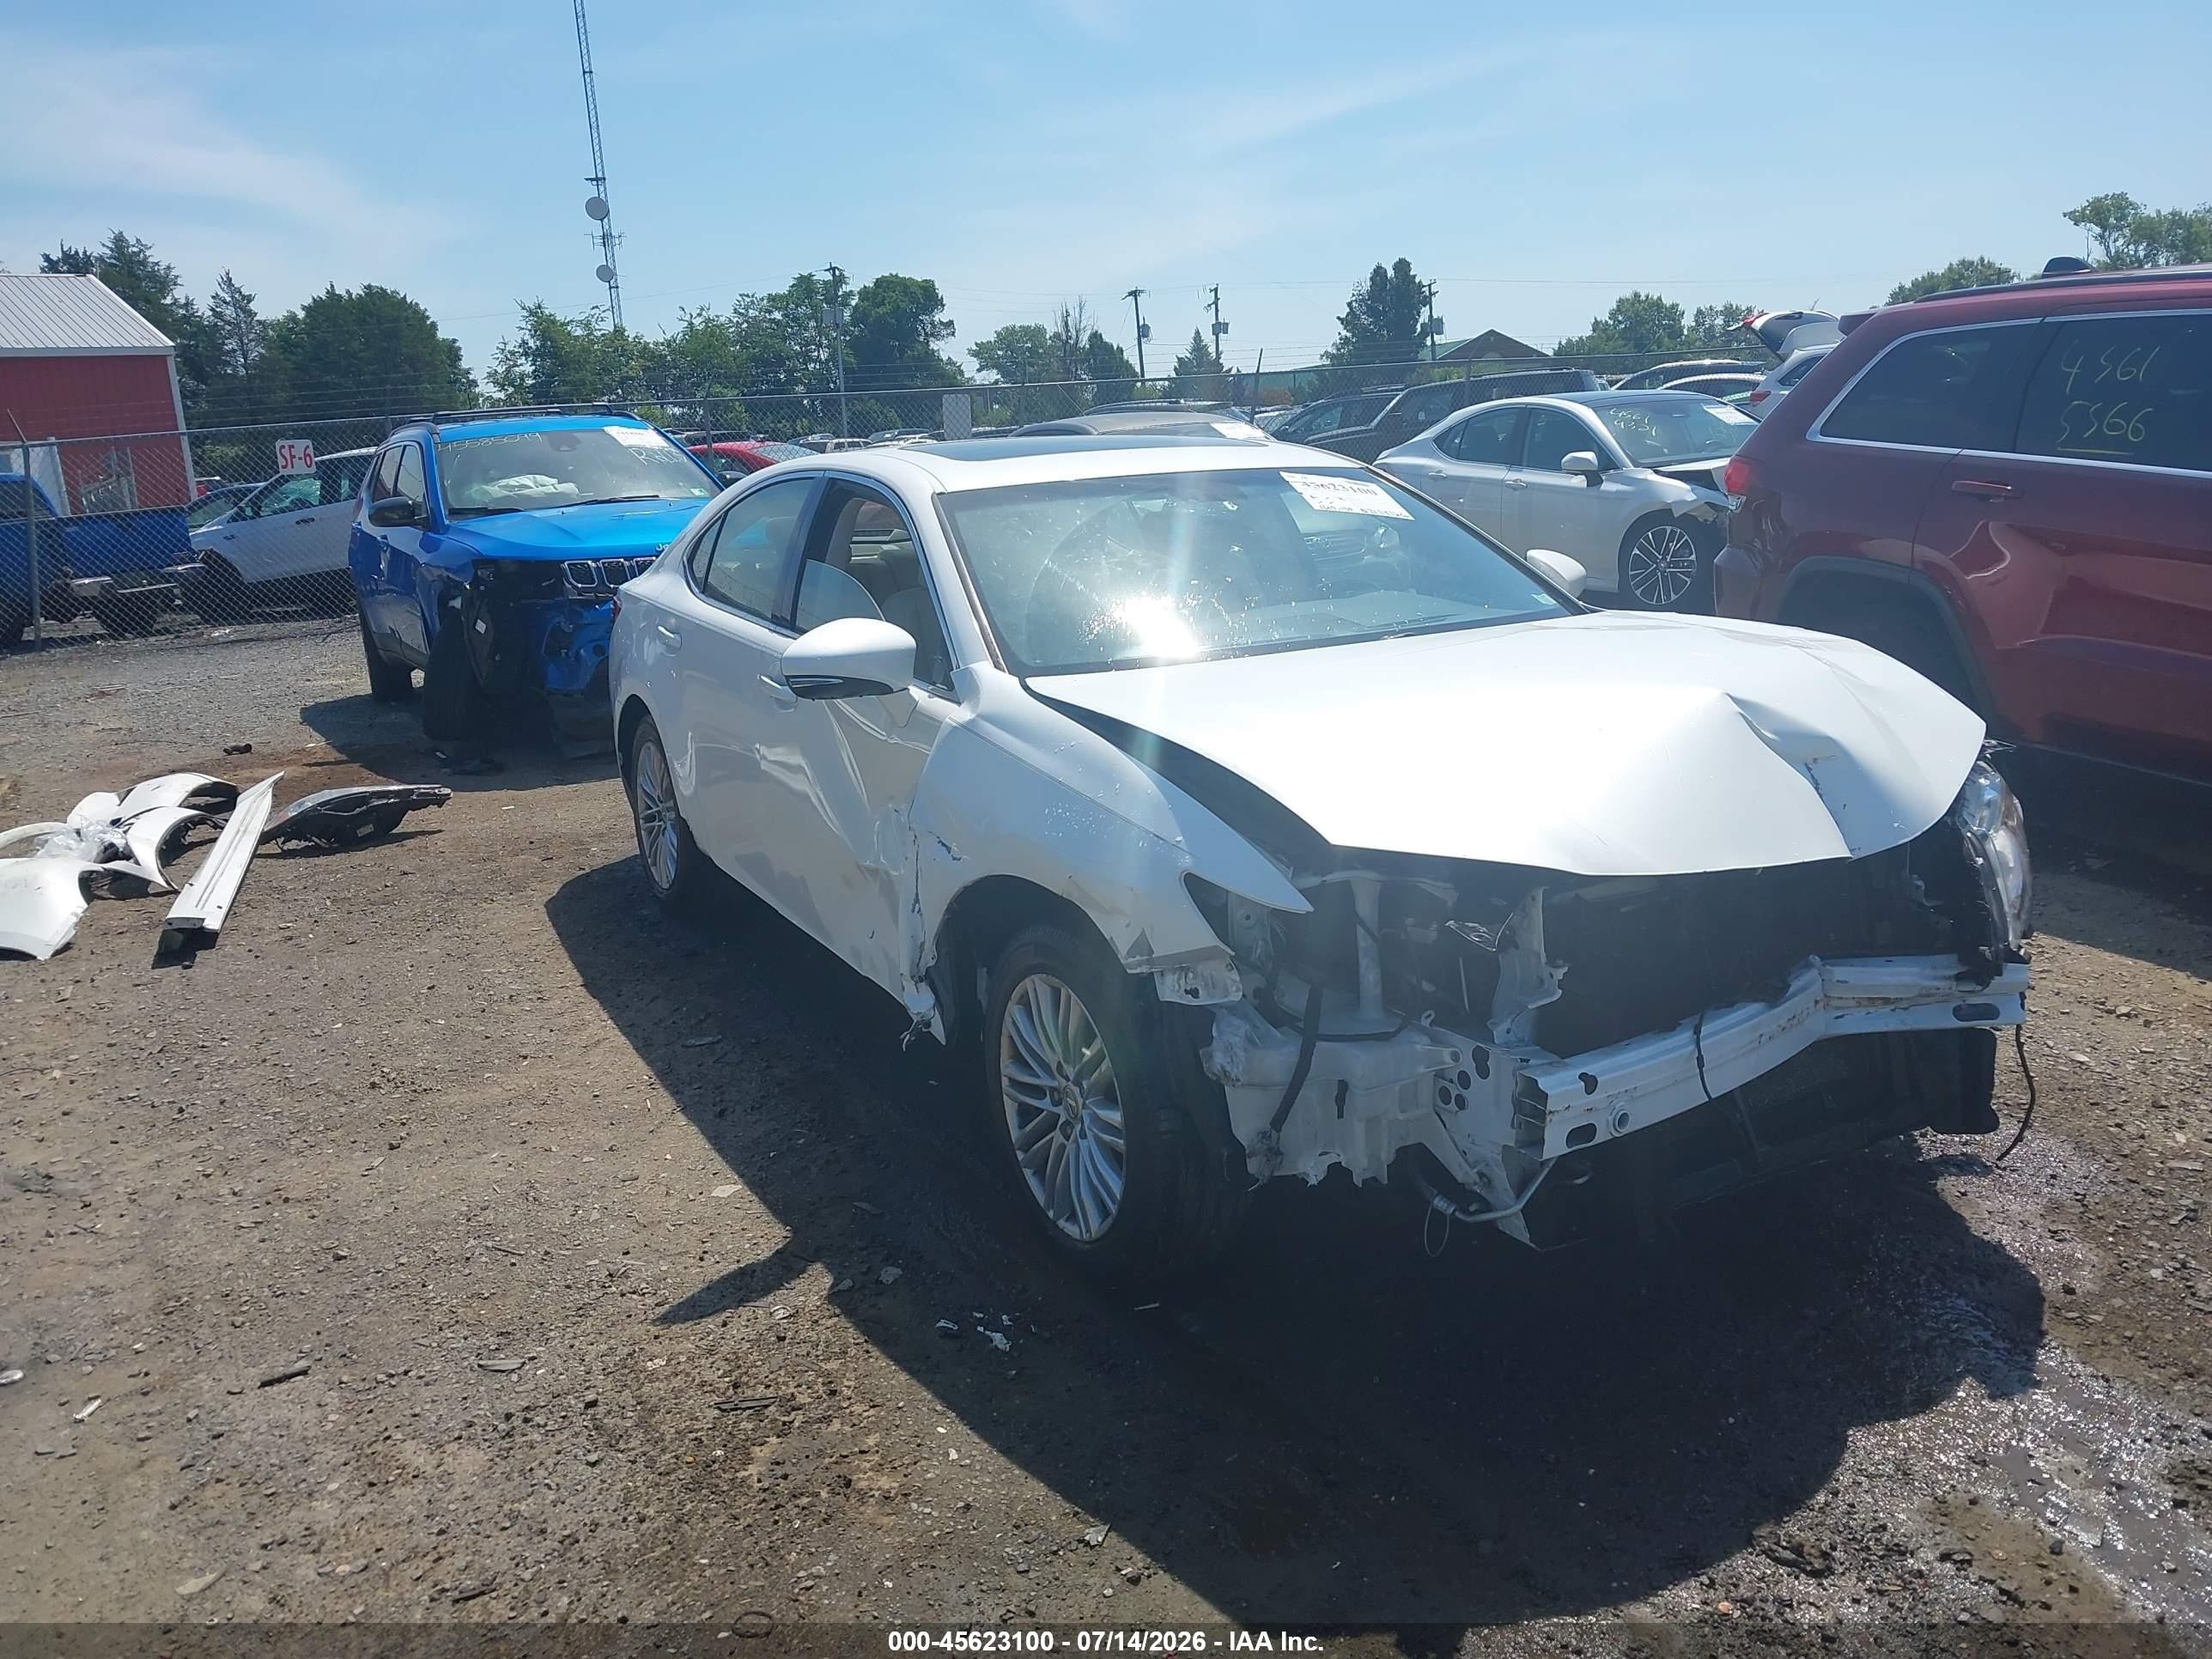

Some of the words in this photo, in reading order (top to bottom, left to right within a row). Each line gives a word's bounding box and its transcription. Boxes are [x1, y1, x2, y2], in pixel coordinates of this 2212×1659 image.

[2057, 400, 2154, 443] 5566
[278, 444, 313, 470] SF-6
[655, 543, 670, 551] Je
